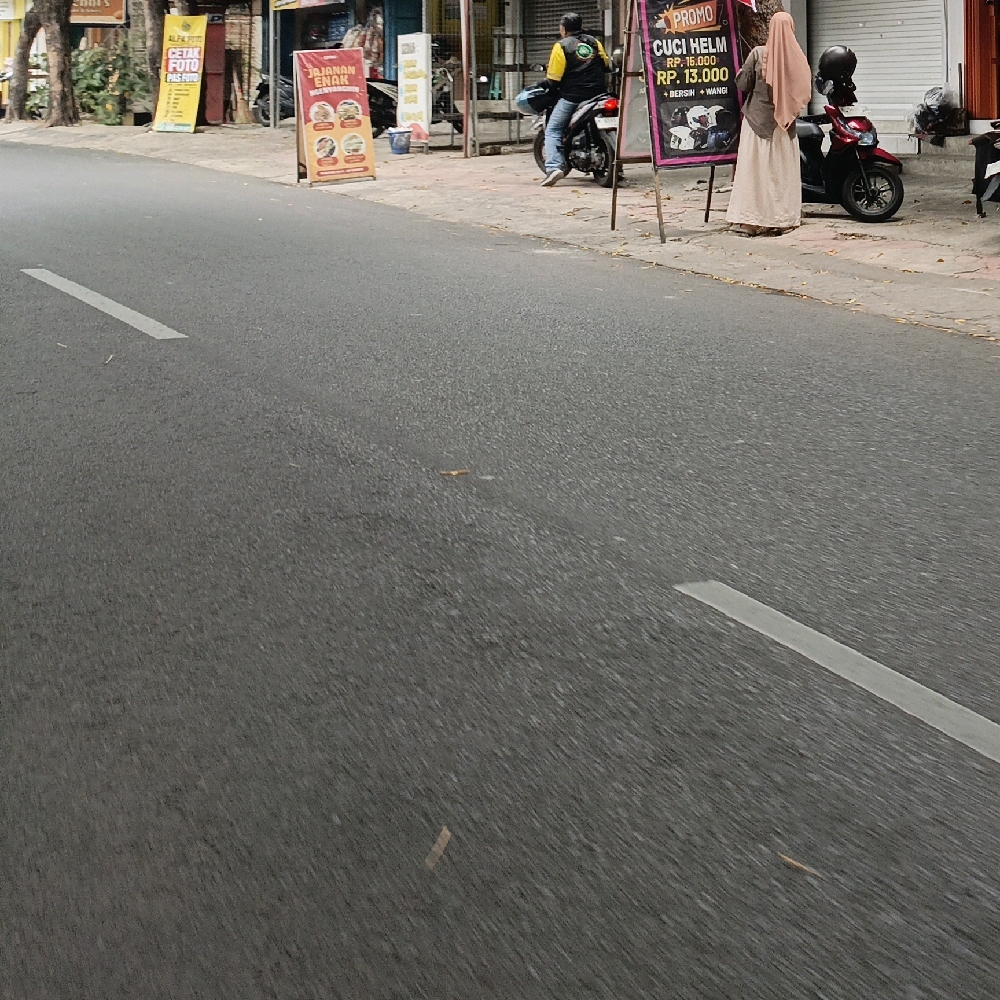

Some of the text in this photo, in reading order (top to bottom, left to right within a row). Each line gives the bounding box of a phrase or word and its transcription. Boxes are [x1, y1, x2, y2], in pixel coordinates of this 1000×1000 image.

[673, 5, 713, 28] PROMO
[168, 47, 200, 59] CETAK
[653, 36, 727, 56] CUCI HELM
[168, 58, 199, 72] FOTO
[666, 57, 683, 68] RP.
[308, 65, 355, 79] JAJANAN
[656, 67, 729, 85] RP. 13.000
[315, 74, 350, 87] ENAK
[669, 86, 728, 98] BERSIH WANGI
